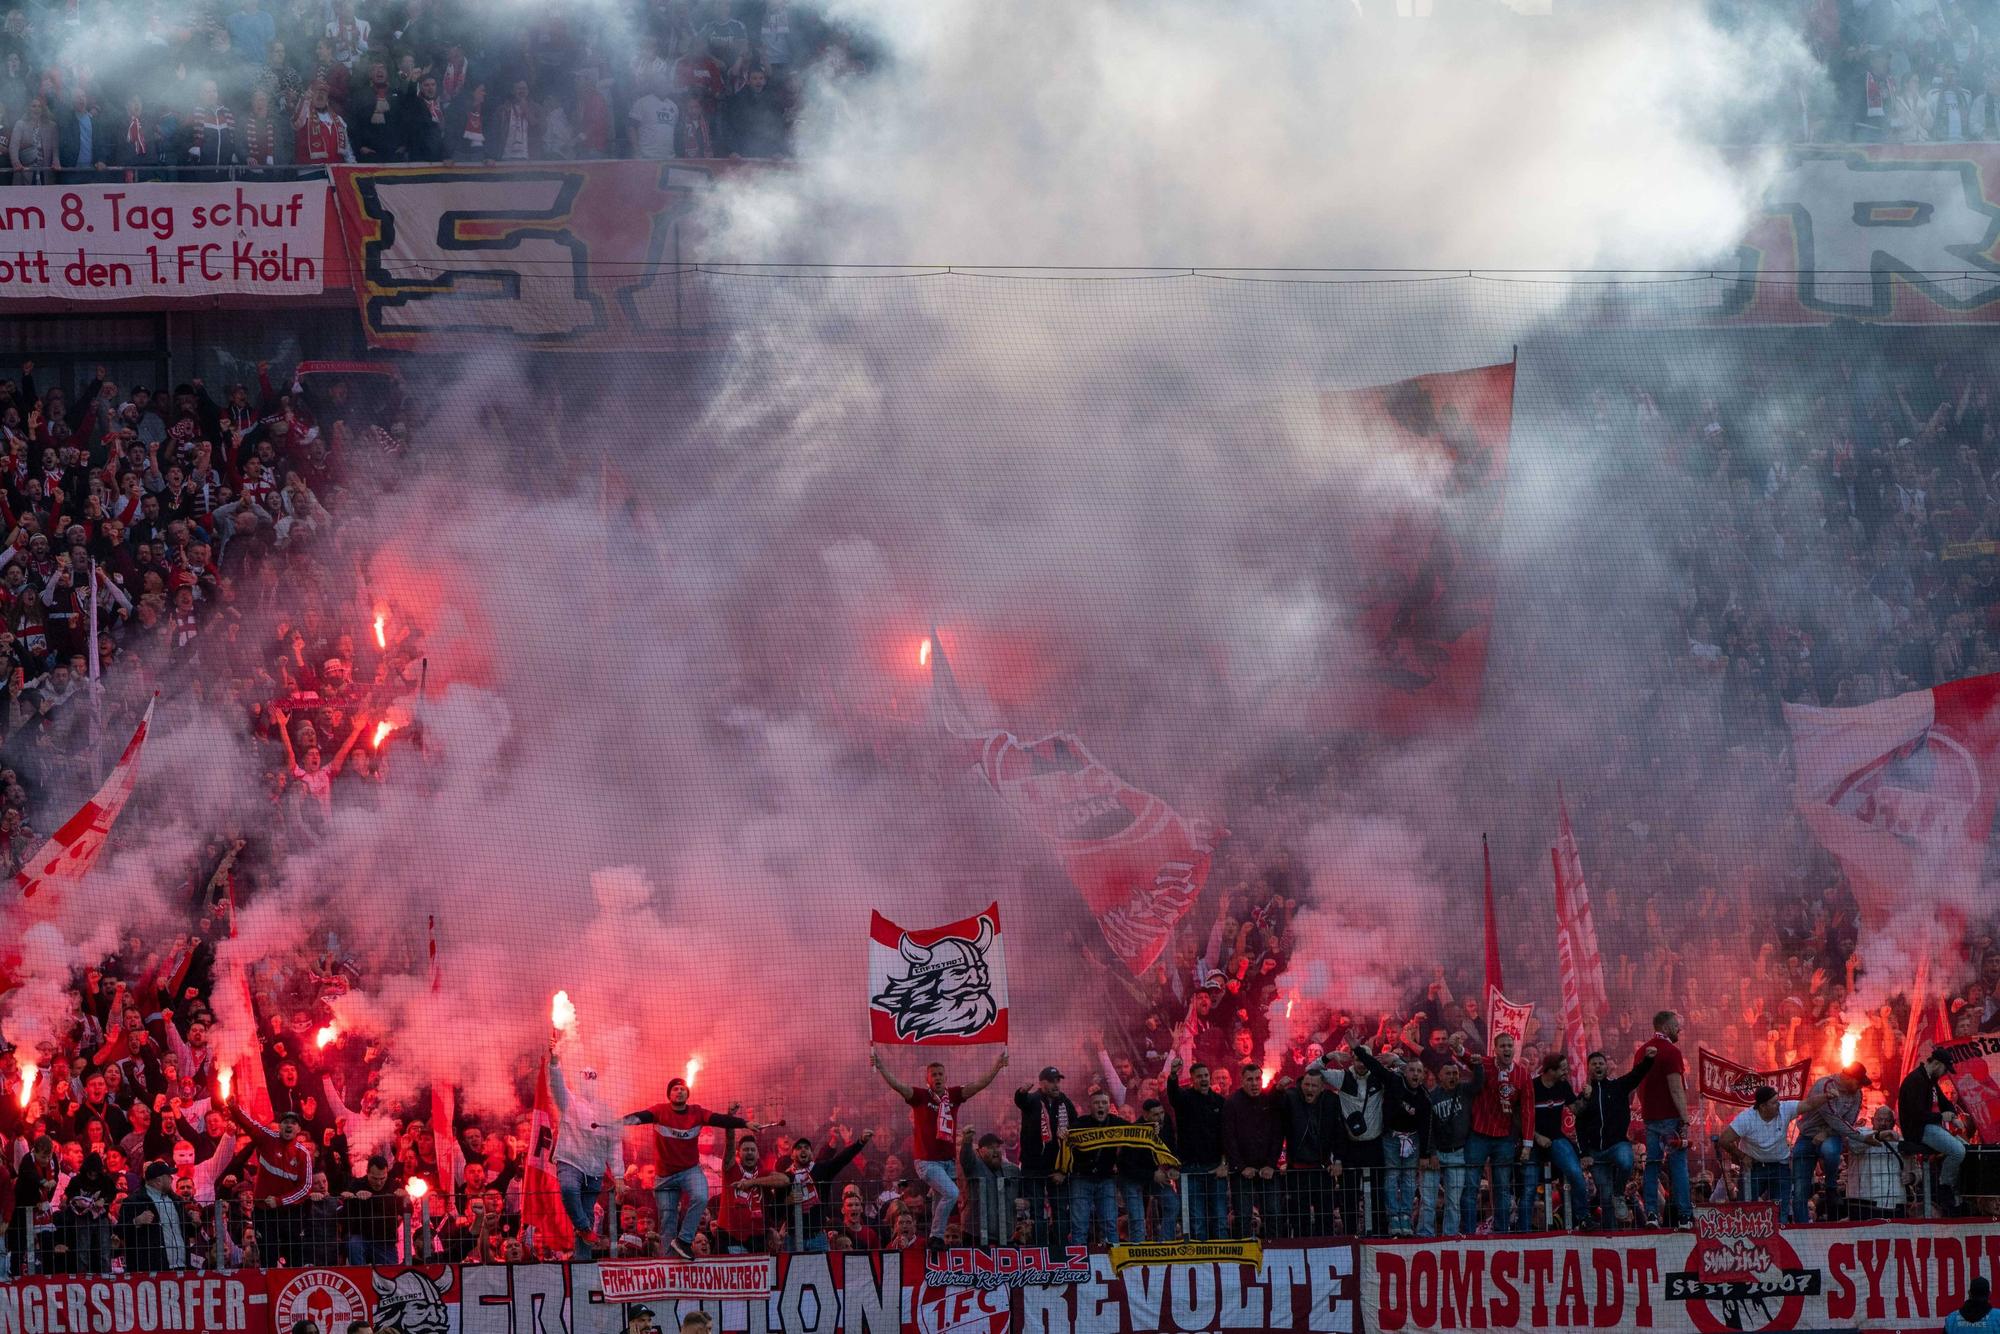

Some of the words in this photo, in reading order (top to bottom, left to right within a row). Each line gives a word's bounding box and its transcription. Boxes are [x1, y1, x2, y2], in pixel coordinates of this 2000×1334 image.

[61, 193, 94, 232] 8.
[104, 193, 174, 239] Tag
[192, 187, 304, 229] schuf
[64, 248, 132, 286] den
[177, 243, 222, 284] FC
[232, 240, 316, 282] Köln
[925, 1245, 1088, 1274] VANDALZ
[1128, 1247, 1178, 1258] BORUSSIA
[1195, 1246, 1244, 1257] DORTMUND
[602, 1265, 666, 1293] FRAKTION
[669, 1264, 769, 1290] STADIONVERBOT
[1022, 1245, 1354, 1334] REVOLTE
[1052, 1267, 1091, 1285] Essen
[1376, 1247, 1660, 1330] DOMSTADT
